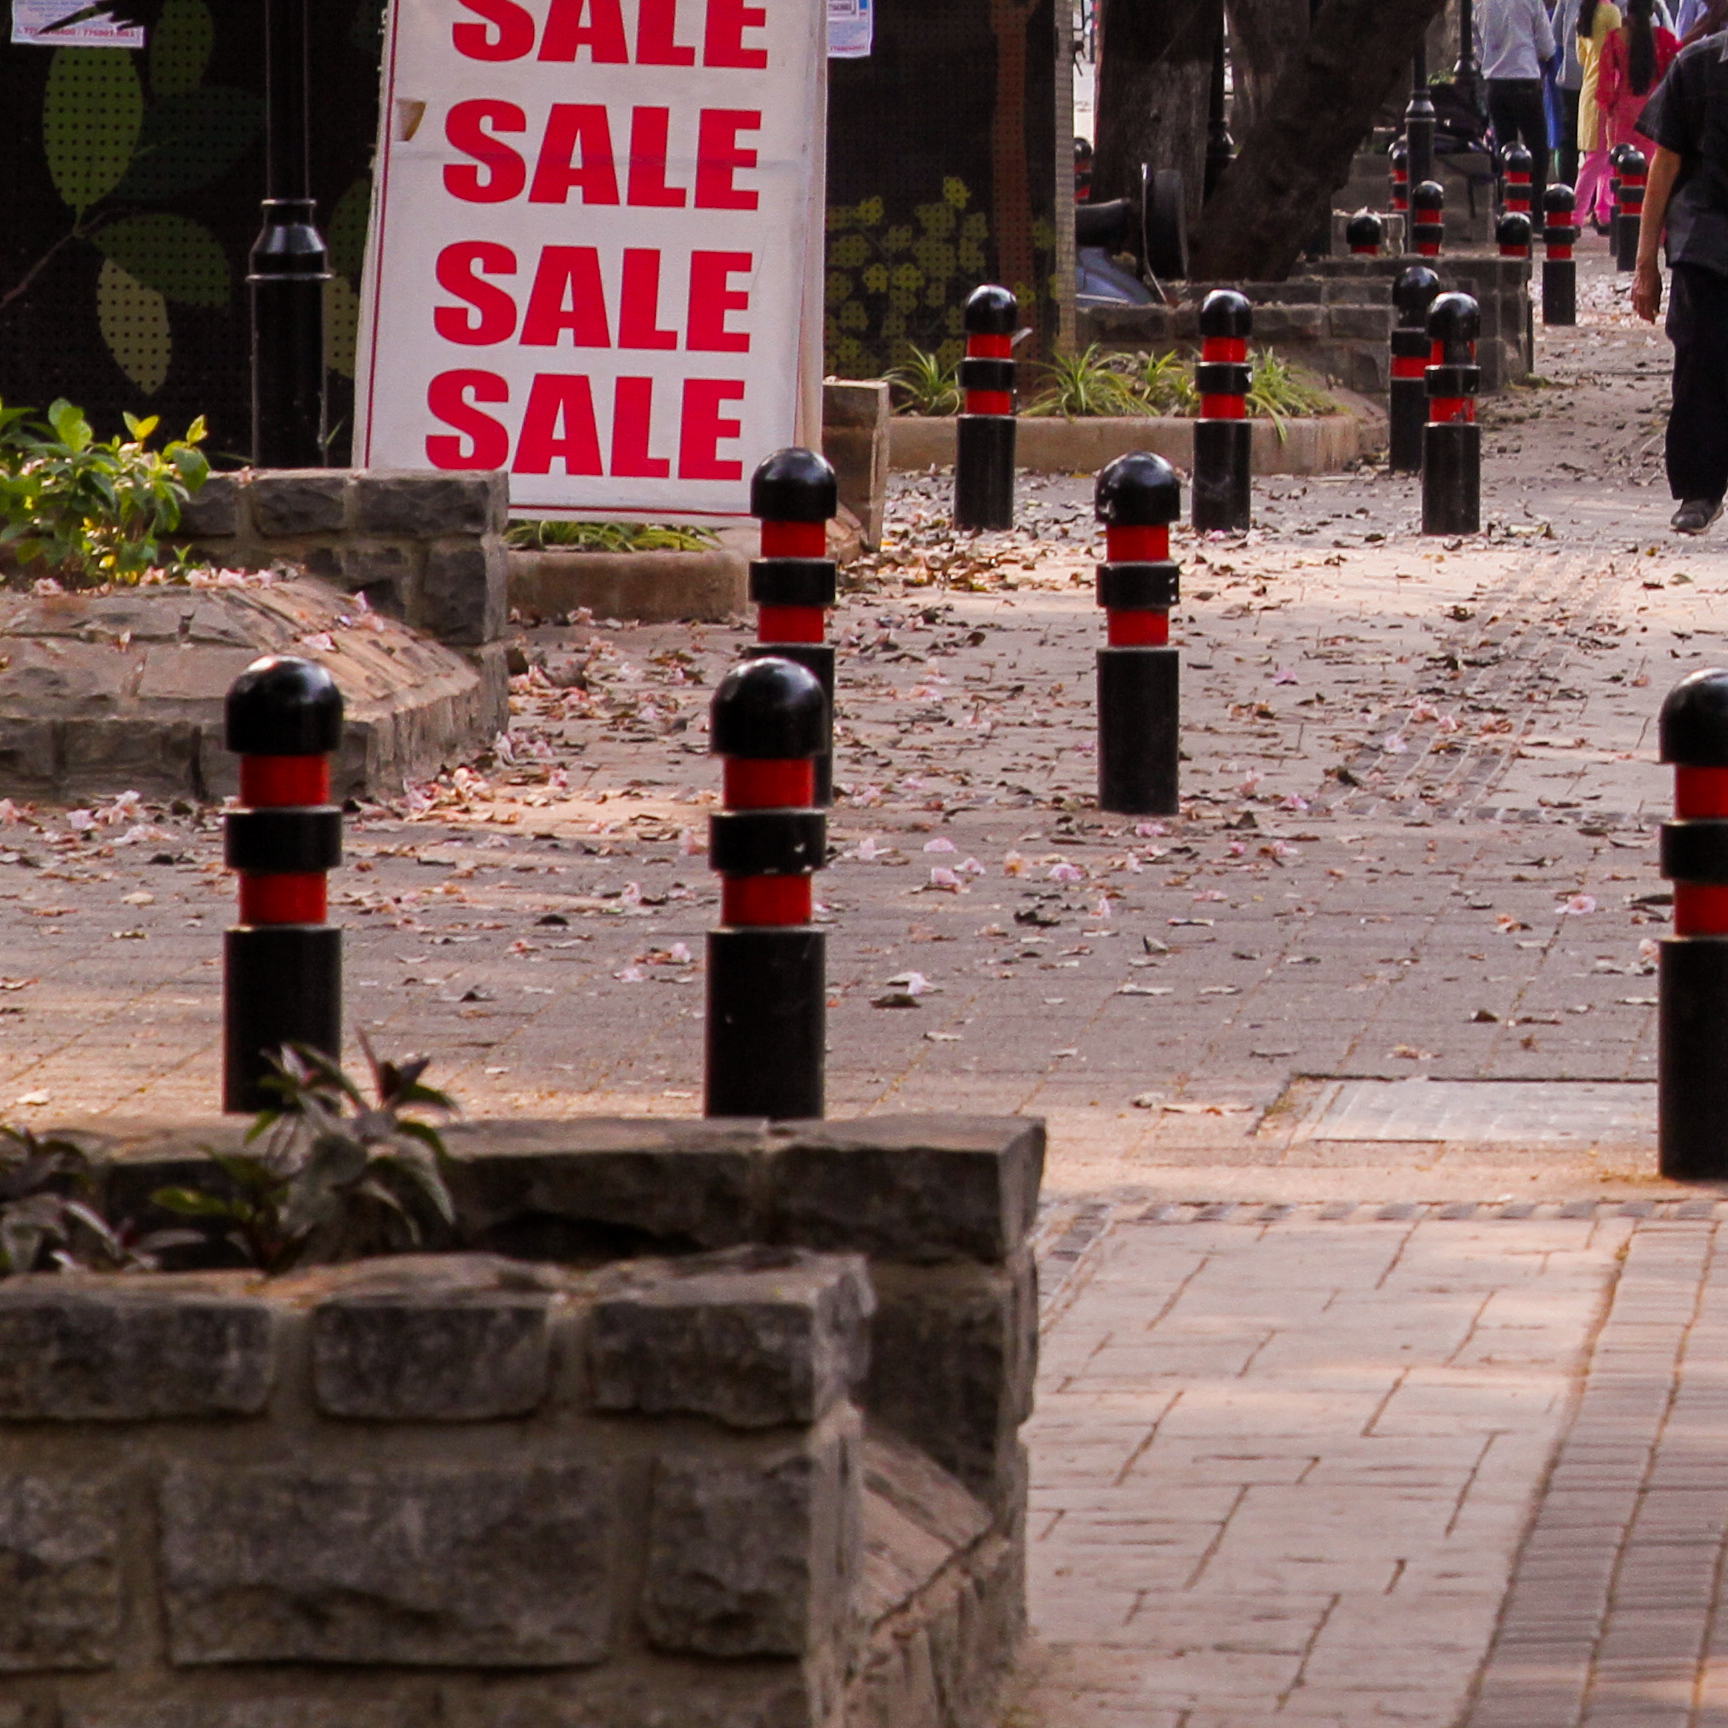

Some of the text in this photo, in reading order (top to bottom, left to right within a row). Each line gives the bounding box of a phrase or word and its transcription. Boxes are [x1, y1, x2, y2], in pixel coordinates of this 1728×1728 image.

[443, 99, 761, 210] SALE
[433, 241, 752, 353] SALE
[425, 369, 744, 481] SALE
